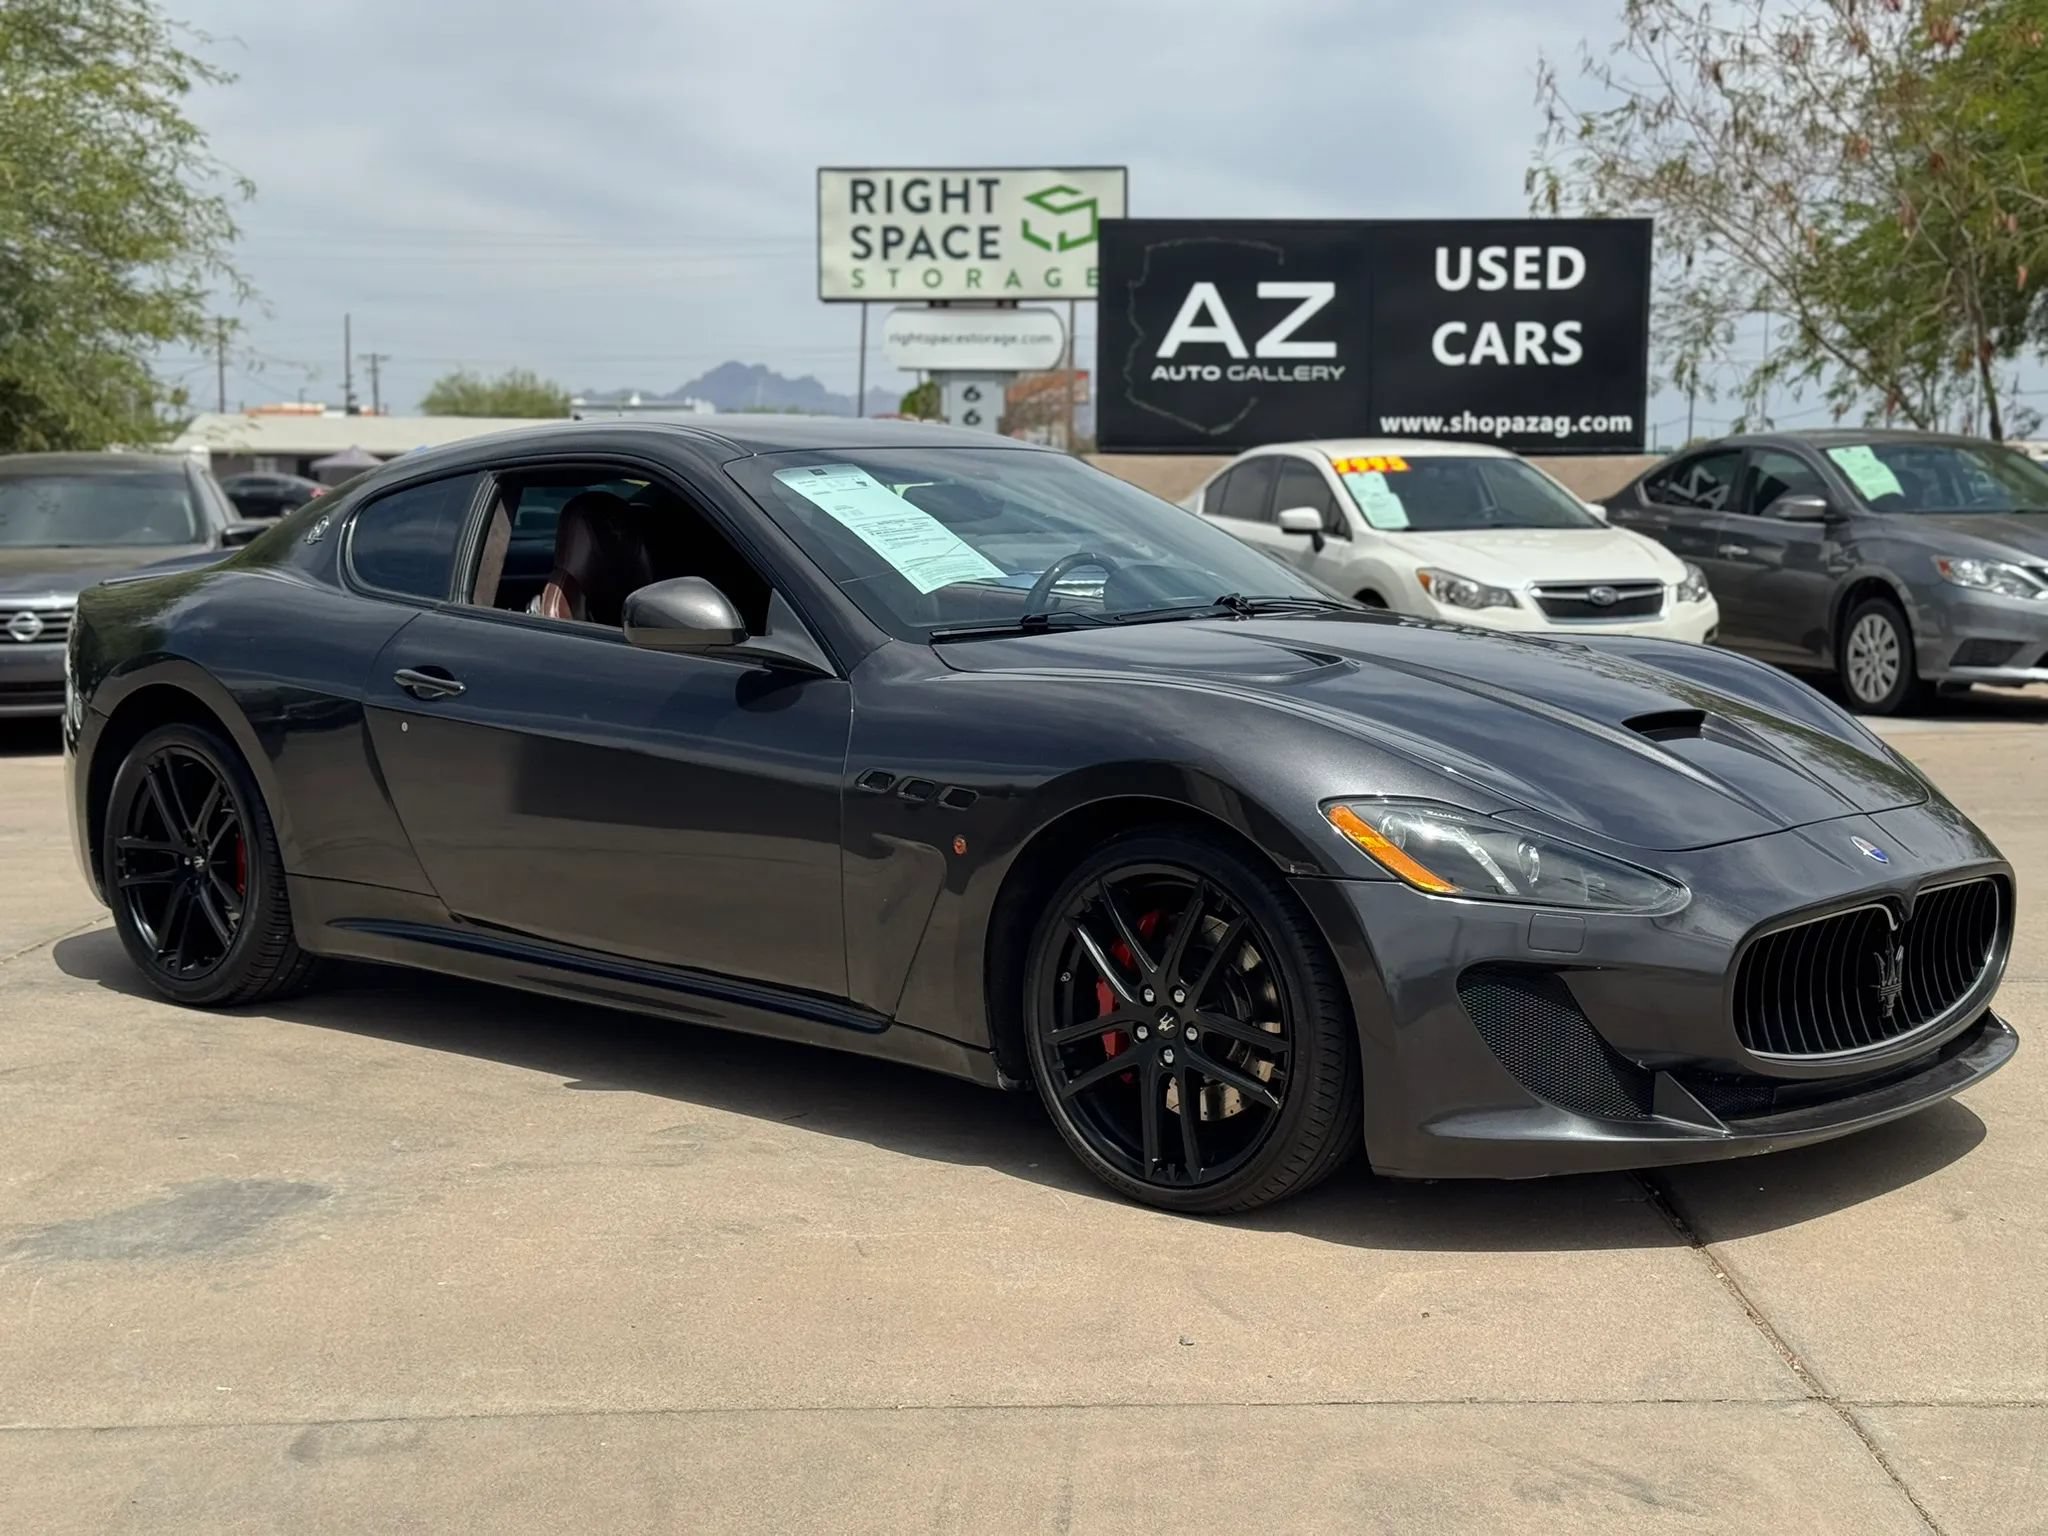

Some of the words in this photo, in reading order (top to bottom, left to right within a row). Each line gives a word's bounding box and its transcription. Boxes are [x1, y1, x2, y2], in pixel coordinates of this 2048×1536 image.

[850, 178, 1000, 214] RIGHT
[851, 225, 1001, 261] SPACE
[851, 267, 1098, 289] STORAGE
[1435, 246, 1587, 291] USED
[1156, 281, 1338, 359] AZ
[889, 331, 1054, 347] rightspacestorage.com
[1431, 320, 1583, 366] CARS
[1151, 365, 1222, 382] AUTO
[1226, 365, 1346, 382] GALLERY
[1380, 410, 1633, 439] www.shopazag.com
